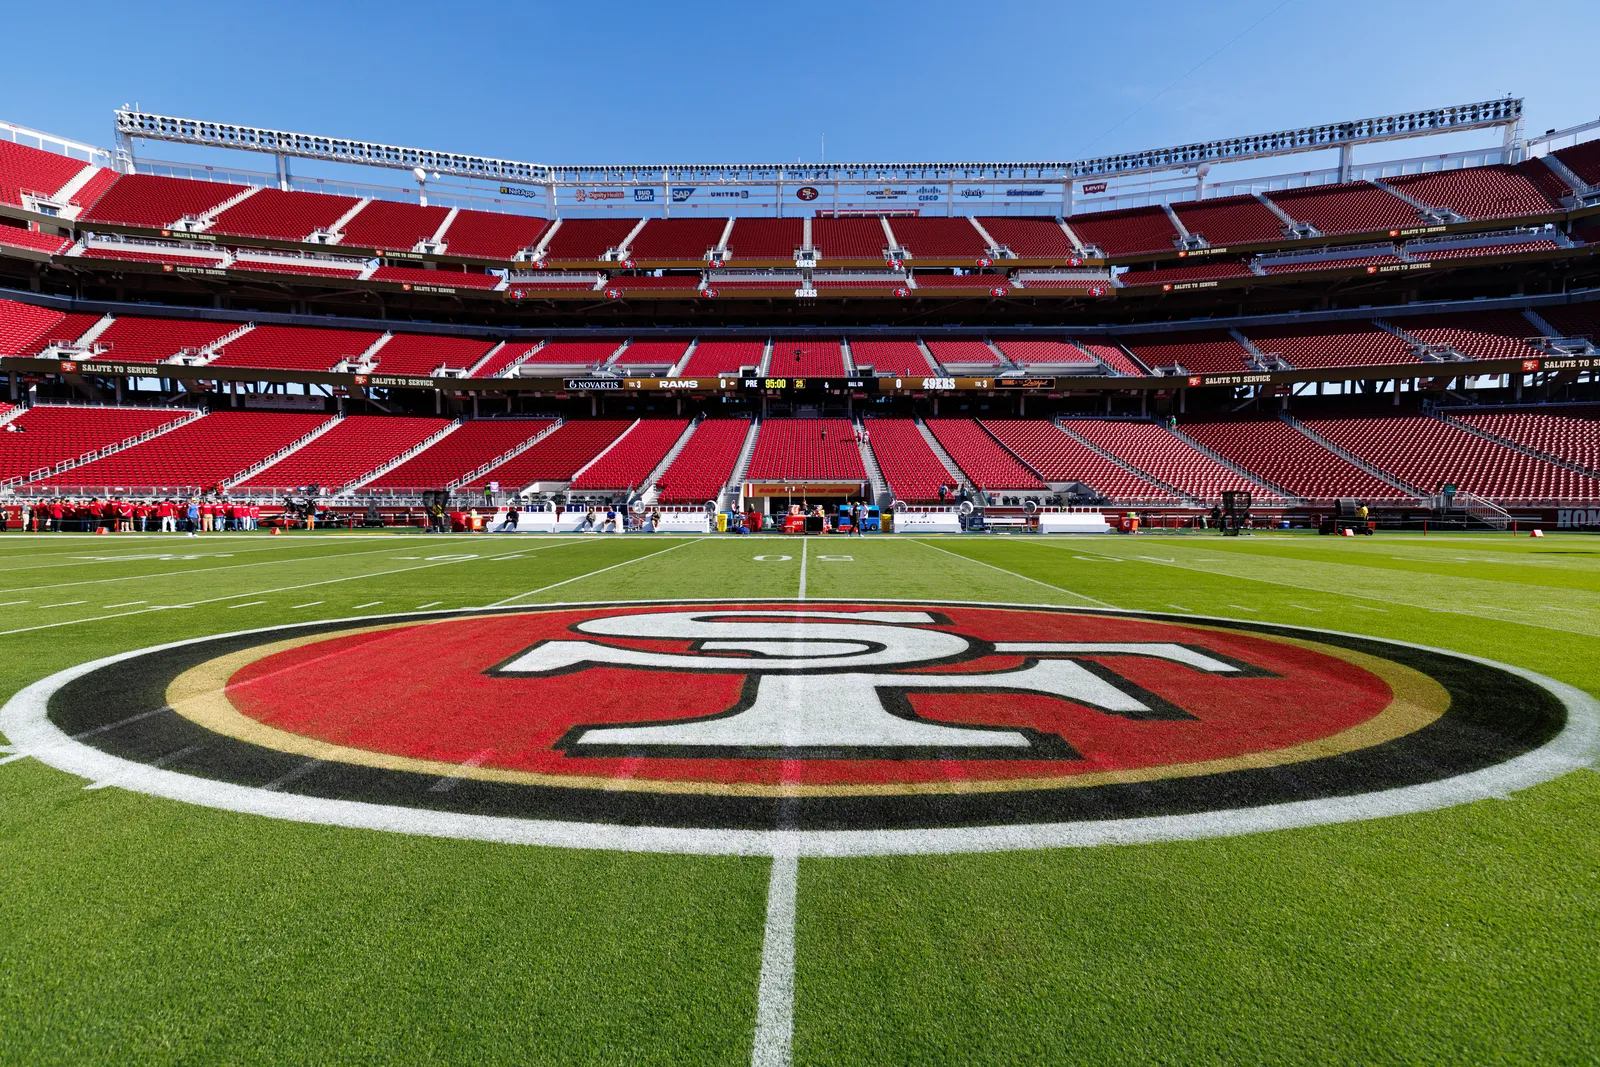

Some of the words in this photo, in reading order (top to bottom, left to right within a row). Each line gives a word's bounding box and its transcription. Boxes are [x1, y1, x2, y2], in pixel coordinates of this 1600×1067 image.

[508, 187, 535, 198] NetApp
[672, 190, 690, 199] SAP
[961, 188, 985, 198] xfinity
[1006, 189, 1045, 197] ticketmaster
[794, 289, 818, 297] 49ERS
[1544, 360, 1576, 369] SALUTE
[1578, 359, 1590, 367] TO
[82, 364, 112, 372] SALUTE
[127, 366, 158, 374] SERVICE
[659, 380, 698, 388] RAMS
[720, 379, 726, 388] 0
[745, 380, 758, 388] PRE
[765, 379, 786, 388] 95:00
[895, 379, 902, 388] 0
[922, 378, 956, 390] 49ERS
[982, 380, 988, 388] 3
[1205, 377, 1231, 385] SALUTE
[484, 608, 1280, 760] SF
